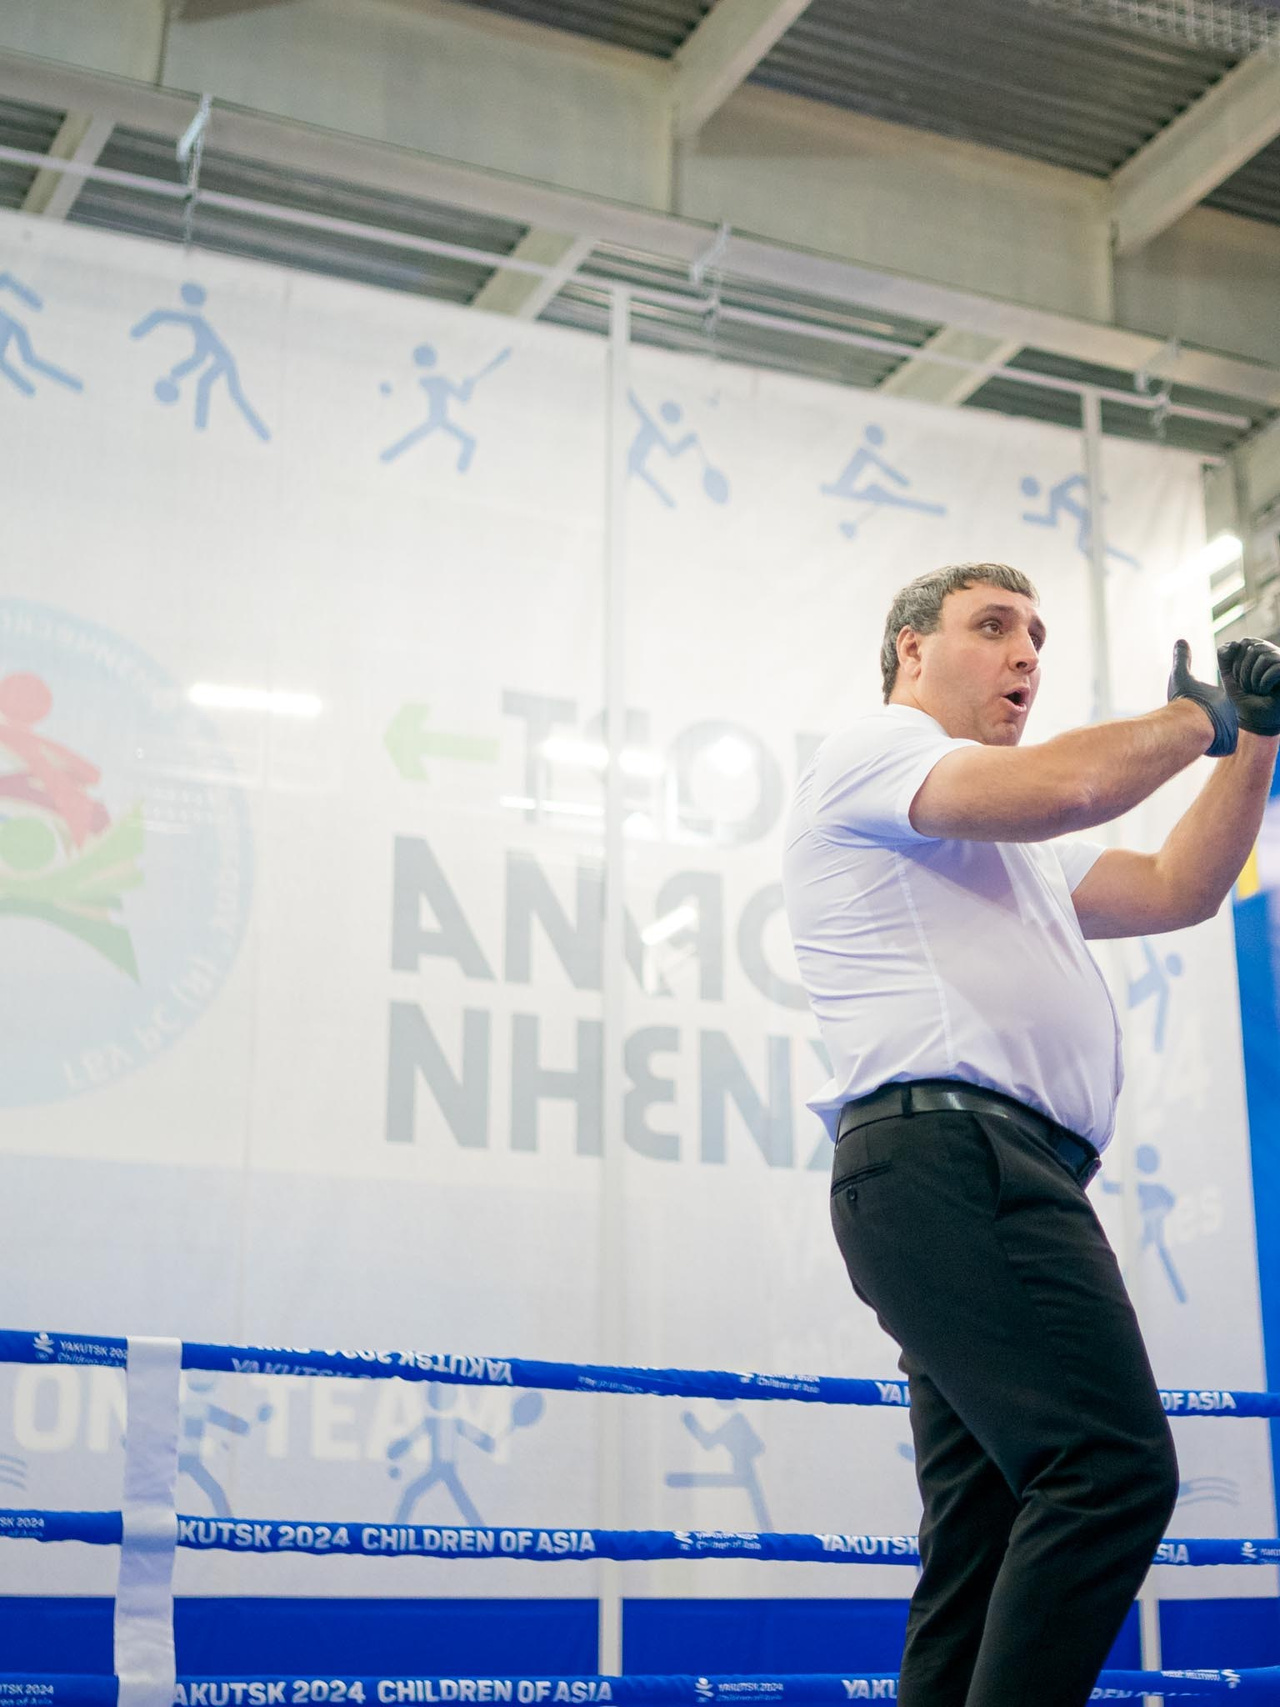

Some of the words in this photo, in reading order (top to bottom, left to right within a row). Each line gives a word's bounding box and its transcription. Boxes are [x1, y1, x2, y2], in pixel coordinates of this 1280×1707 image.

[59, 1340, 108, 1357] YAKUTSK
[109, 1346, 127, 1360] 202
[398, 1350, 513, 1386] YAKUTSK
[1186, 1391, 1237, 1411] ASIA
[16, 1516, 45, 1529] 2024
[178, 1519, 272, 1549] KUTSK
[277, 1525, 351, 1550] 2024
[361, 1527, 496, 1554] CHILDREN
[499, 1530, 533, 1553] OF
[535, 1530, 597, 1554] ASIA
[0, 1683, 24, 1695] TSK
[25, 1683, 55, 1696] 2024
[172, 1681, 287, 1707] AKUTSK
[291, 1679, 367, 1705] 2024
[377, 1679, 513, 1704] CHILDREN
[516, 1680, 552, 1704] OF
[552, 1680, 614, 1703] ASIA
